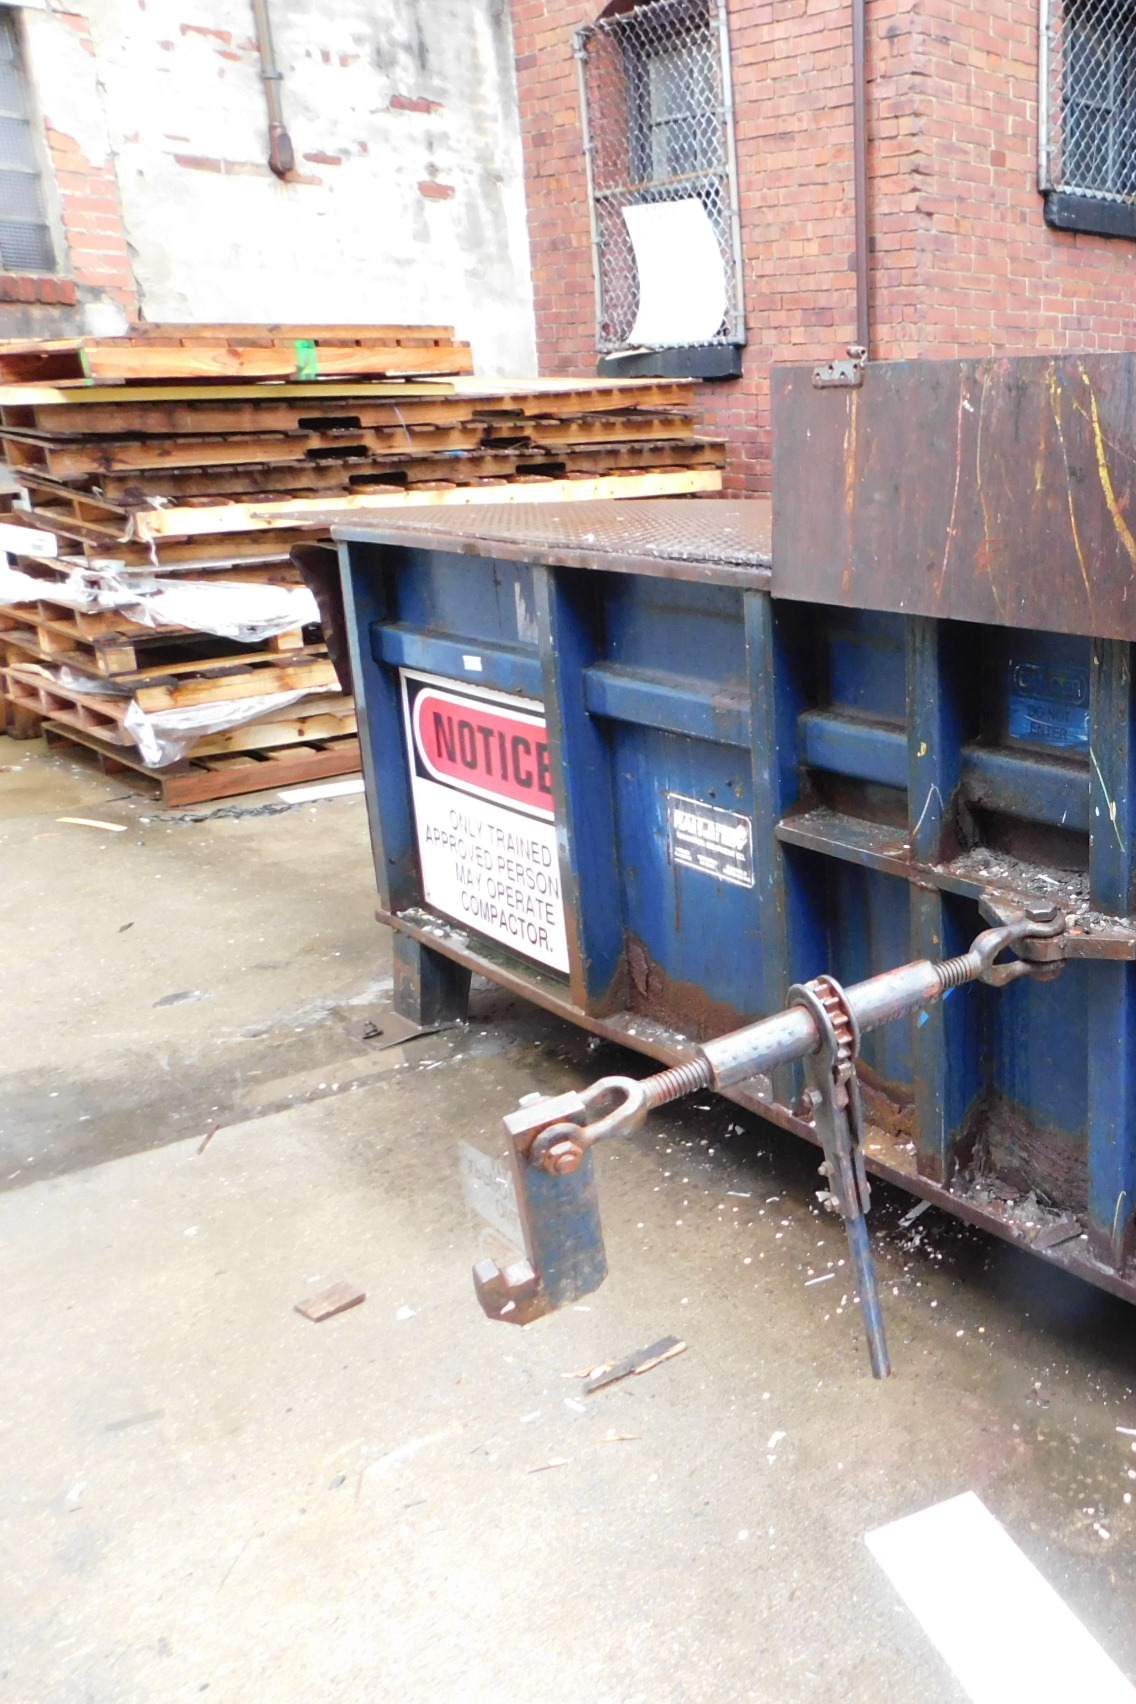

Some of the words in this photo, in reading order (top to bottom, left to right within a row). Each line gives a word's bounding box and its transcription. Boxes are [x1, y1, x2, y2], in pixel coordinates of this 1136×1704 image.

[1028, 705, 1044, 718] DO
[1048, 708, 1070, 722] NOT
[1030, 721, 1067, 740] ENTER
[433, 711, 554, 795] NOTICE
[425, 823, 493, 871] APPROVED
[449, 809, 483, 838] ONLY
[487, 823, 552, 868] TRAINED
[455, 862, 482, 891] MAY
[487, 877, 556, 926] OPERATE
[461, 890, 555, 953] COMPACTOR.
